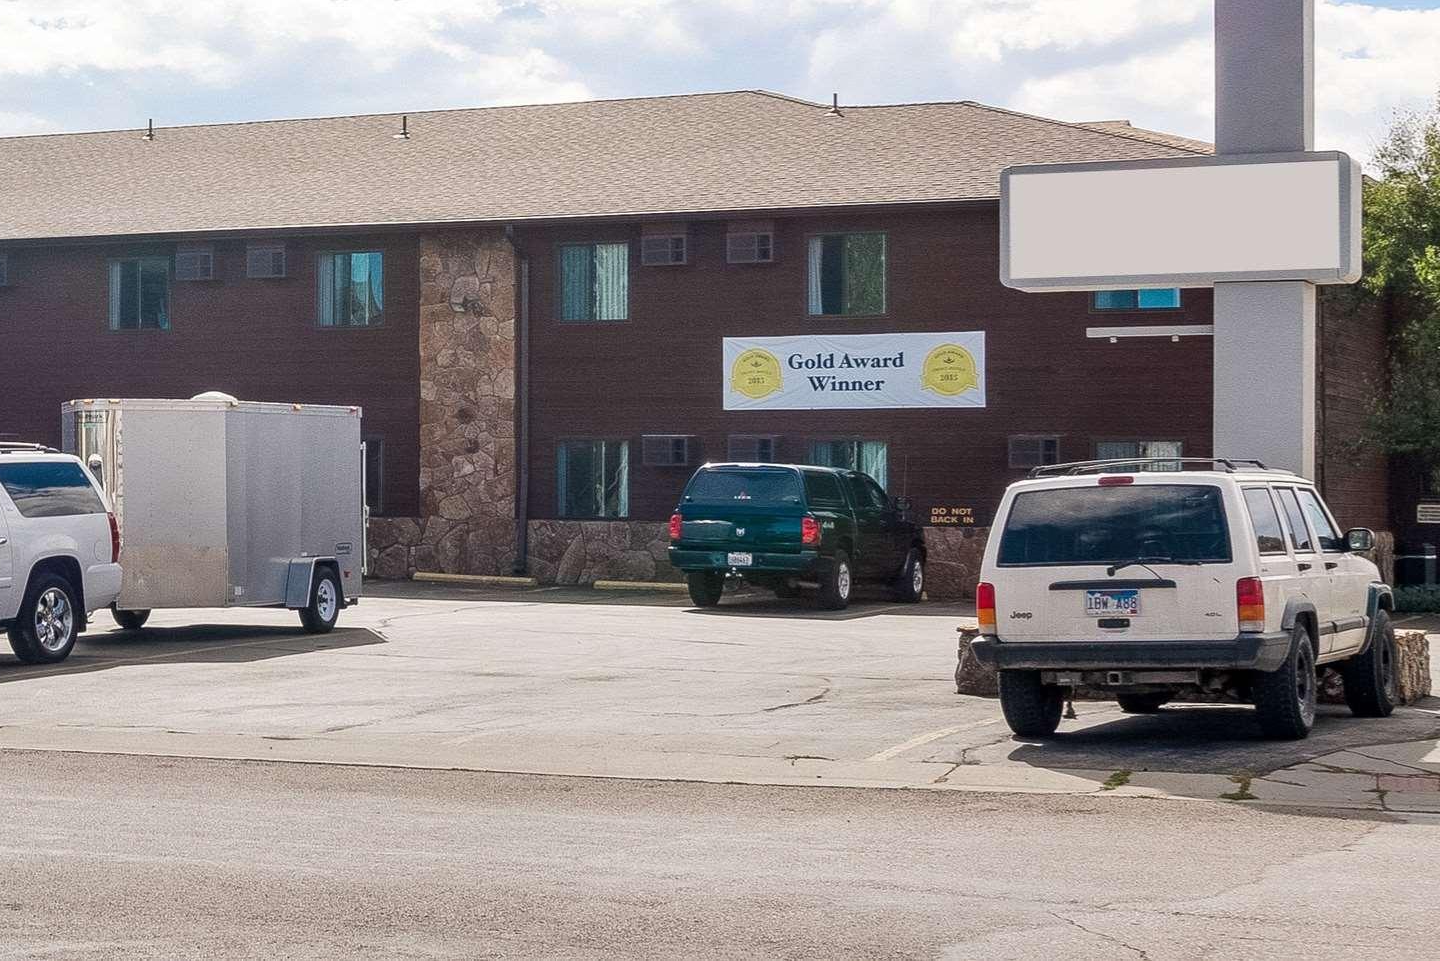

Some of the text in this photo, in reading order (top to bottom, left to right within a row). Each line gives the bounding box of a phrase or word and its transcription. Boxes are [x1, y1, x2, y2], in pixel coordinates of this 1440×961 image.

[788, 353, 835, 370] Gold
[838, 352, 905, 369] Award
[807, 375, 885, 391] Winner
[931, 507, 972, 515] DO NOT
[930, 515, 958, 523] BACK
[1010, 610, 1033, 620] Jeep
